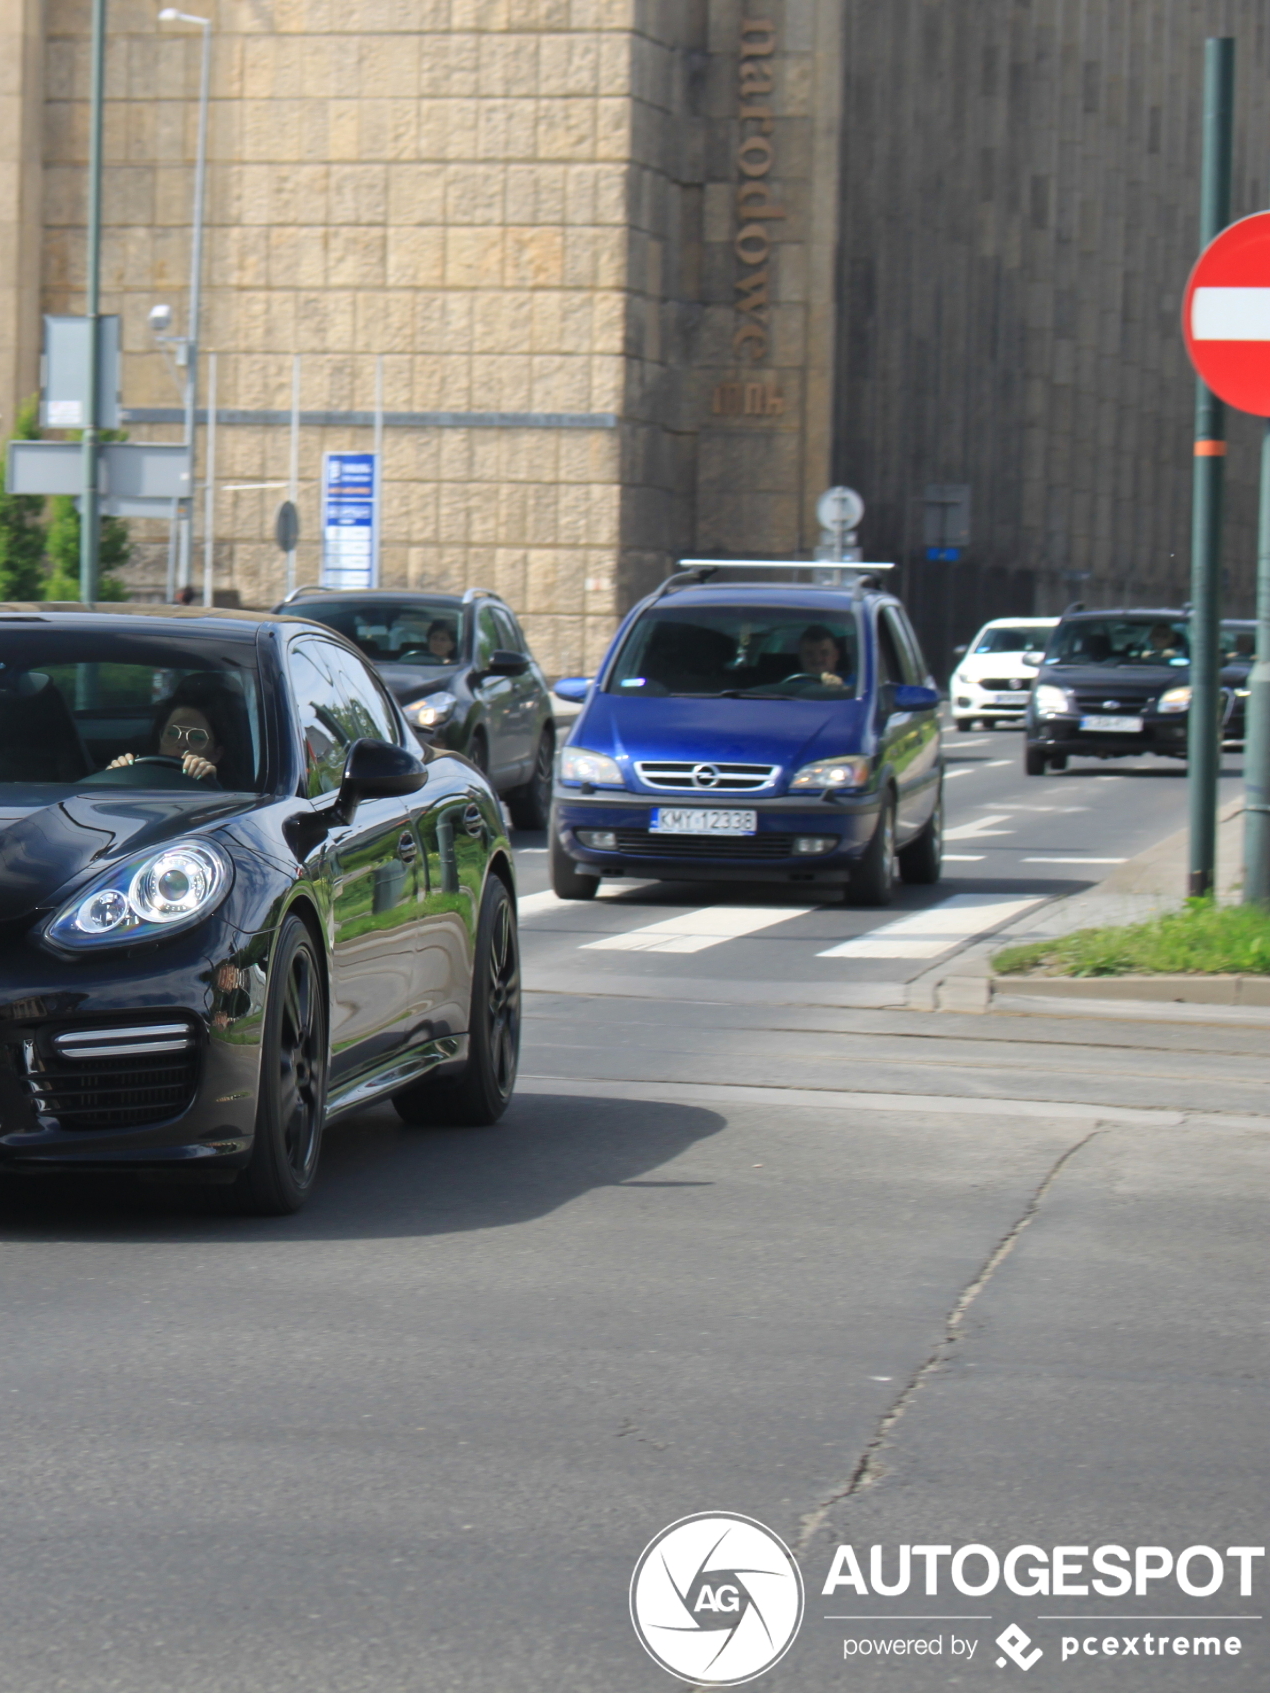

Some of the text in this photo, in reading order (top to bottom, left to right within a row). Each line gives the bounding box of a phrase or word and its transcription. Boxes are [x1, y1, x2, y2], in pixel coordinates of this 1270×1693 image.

[734, 18, 786, 361] narodowe
[660, 810, 694, 829] KMY
[701, 811, 753, 829] 12338
